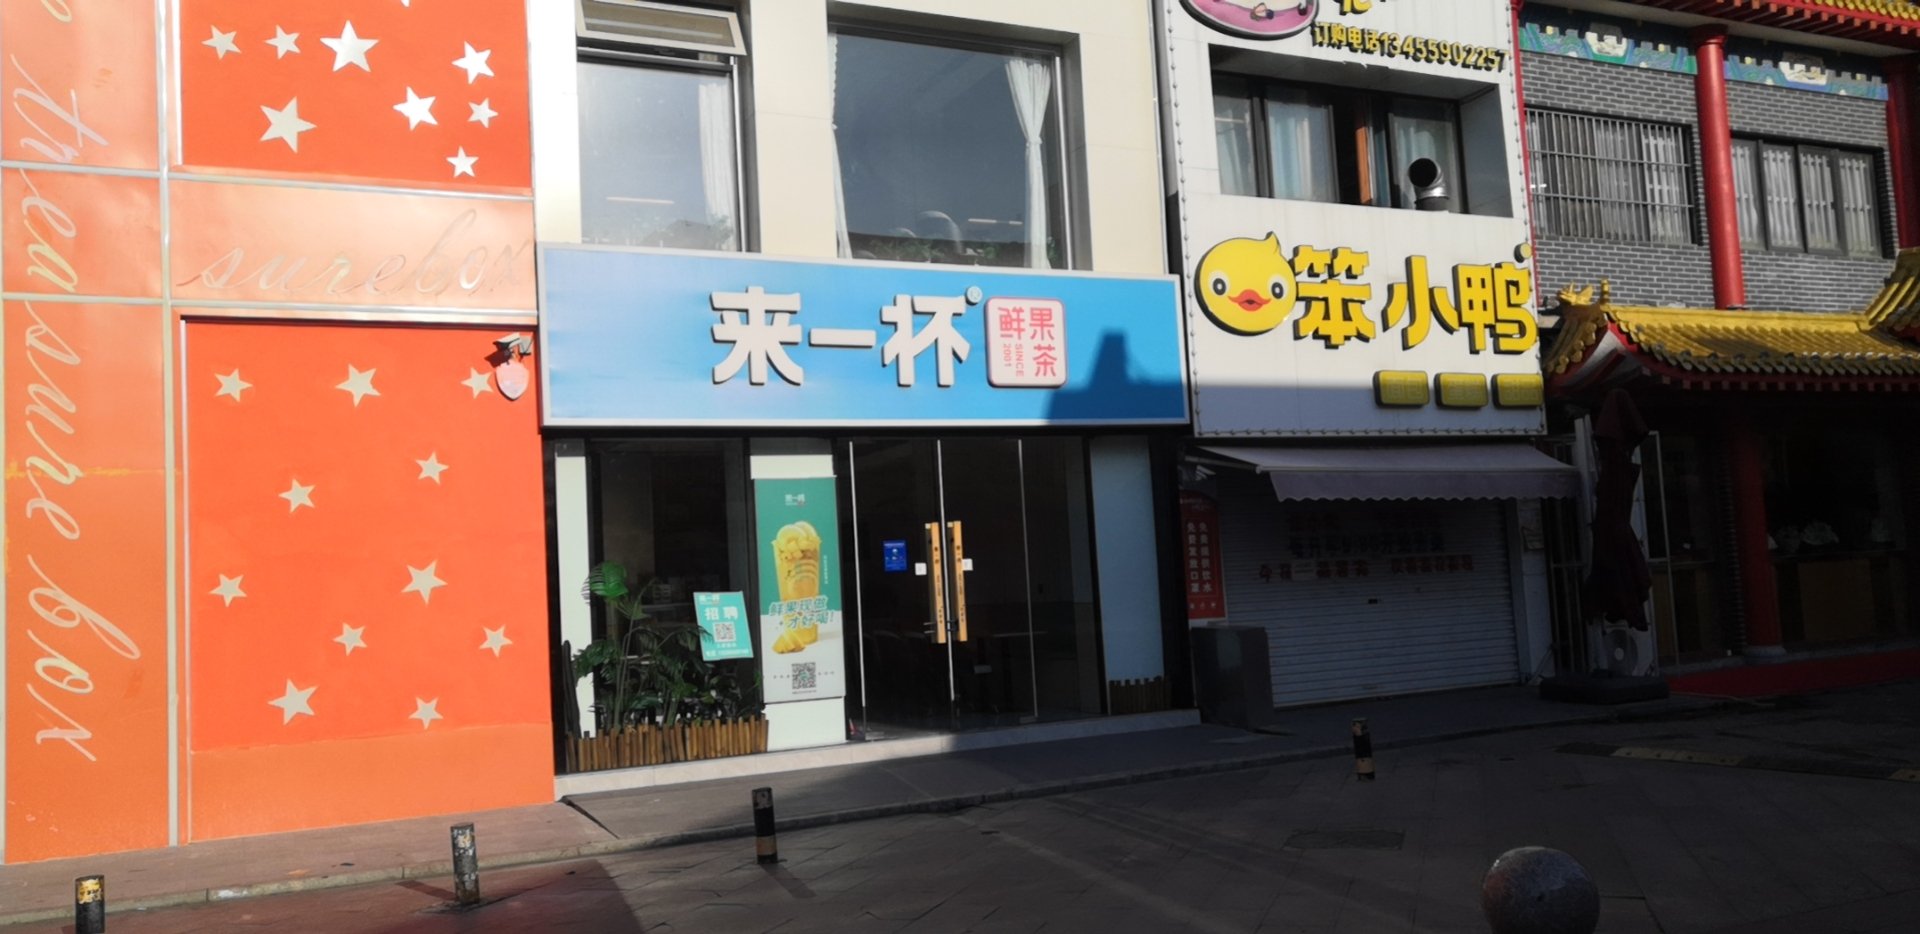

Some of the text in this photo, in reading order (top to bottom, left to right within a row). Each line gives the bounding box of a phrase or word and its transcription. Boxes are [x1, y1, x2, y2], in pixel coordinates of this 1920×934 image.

[710, 286, 971, 387] 来一杯
[1291, 245, 1539, 353] 笨小鸭
[1015, 343, 1025, 378] SINCE
[27, 555, 141, 762] box
